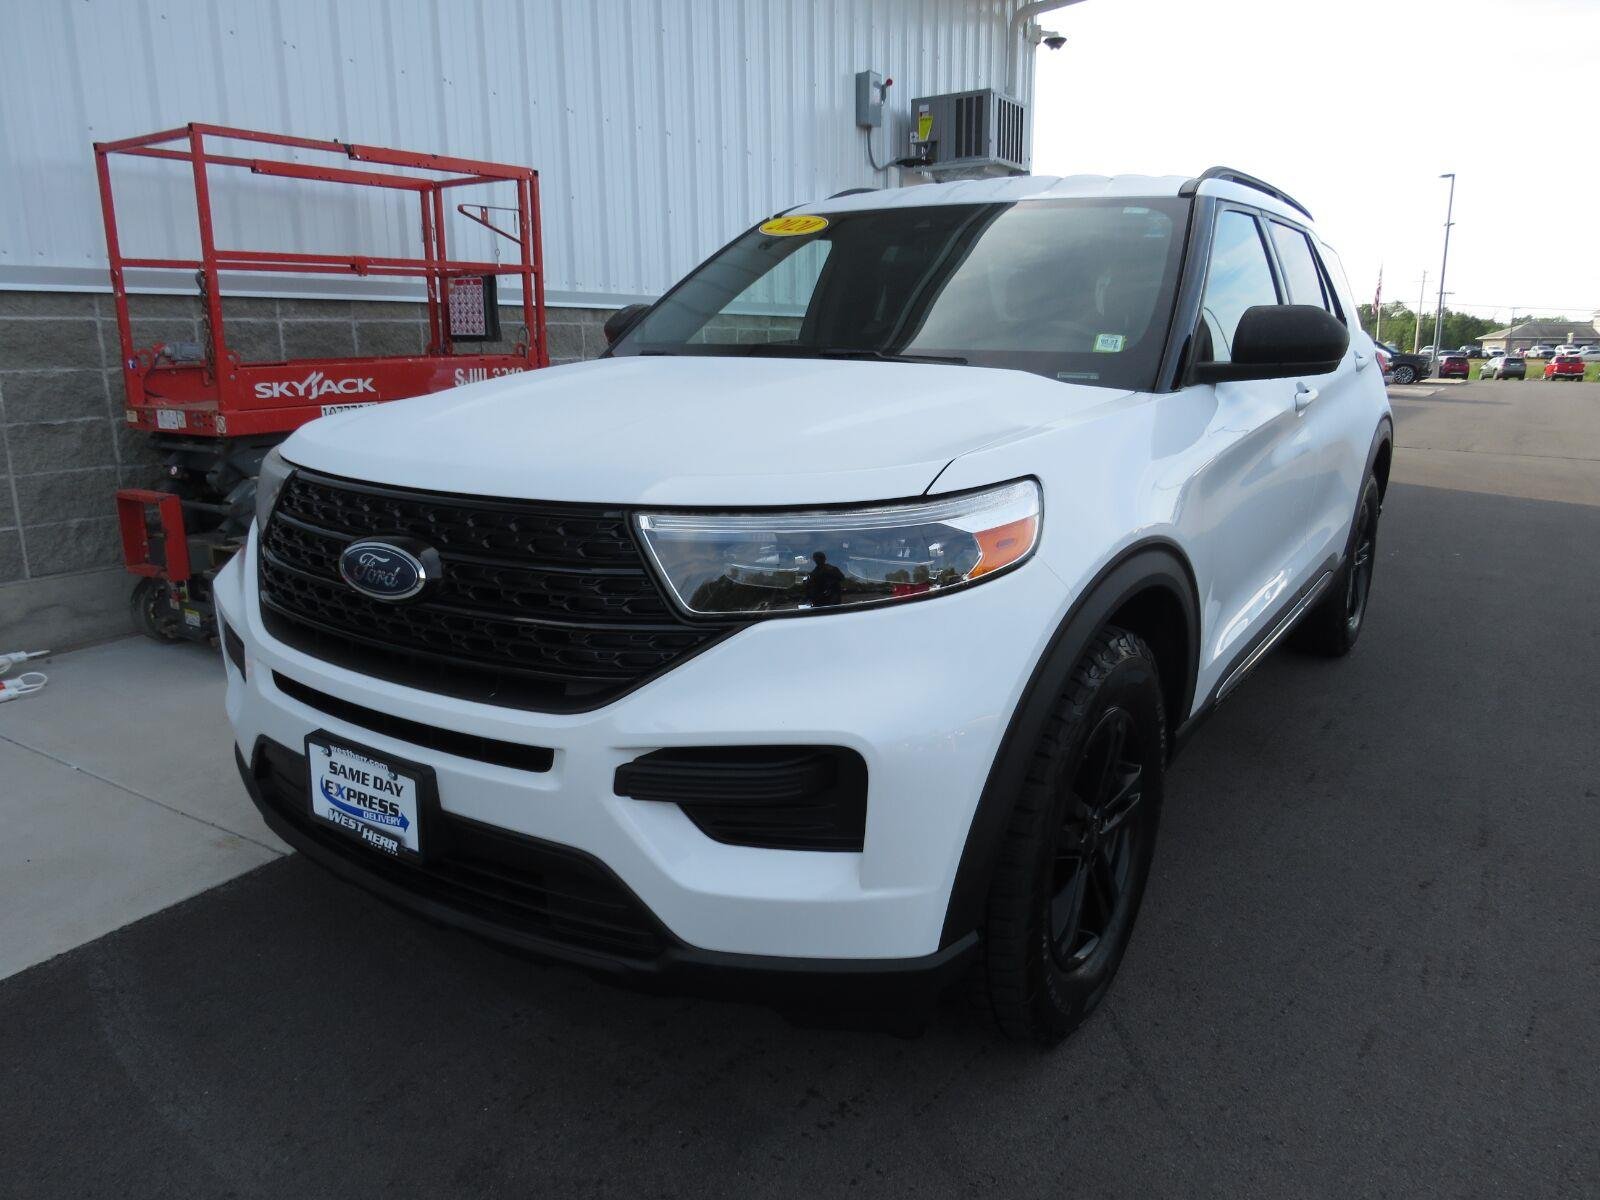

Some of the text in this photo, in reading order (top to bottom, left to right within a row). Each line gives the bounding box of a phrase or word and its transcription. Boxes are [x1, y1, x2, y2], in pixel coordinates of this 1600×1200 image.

[254, 371, 376, 399] SKYJACK
[353, 552, 400, 588] Ford
[329, 761, 404, 797] SAME DAY
[324, 780, 400, 817] EXPRESS
[328, 808, 364, 832] WEST
[362, 828, 398, 852] HERR
[363, 811, 402, 826] DELIVERY
